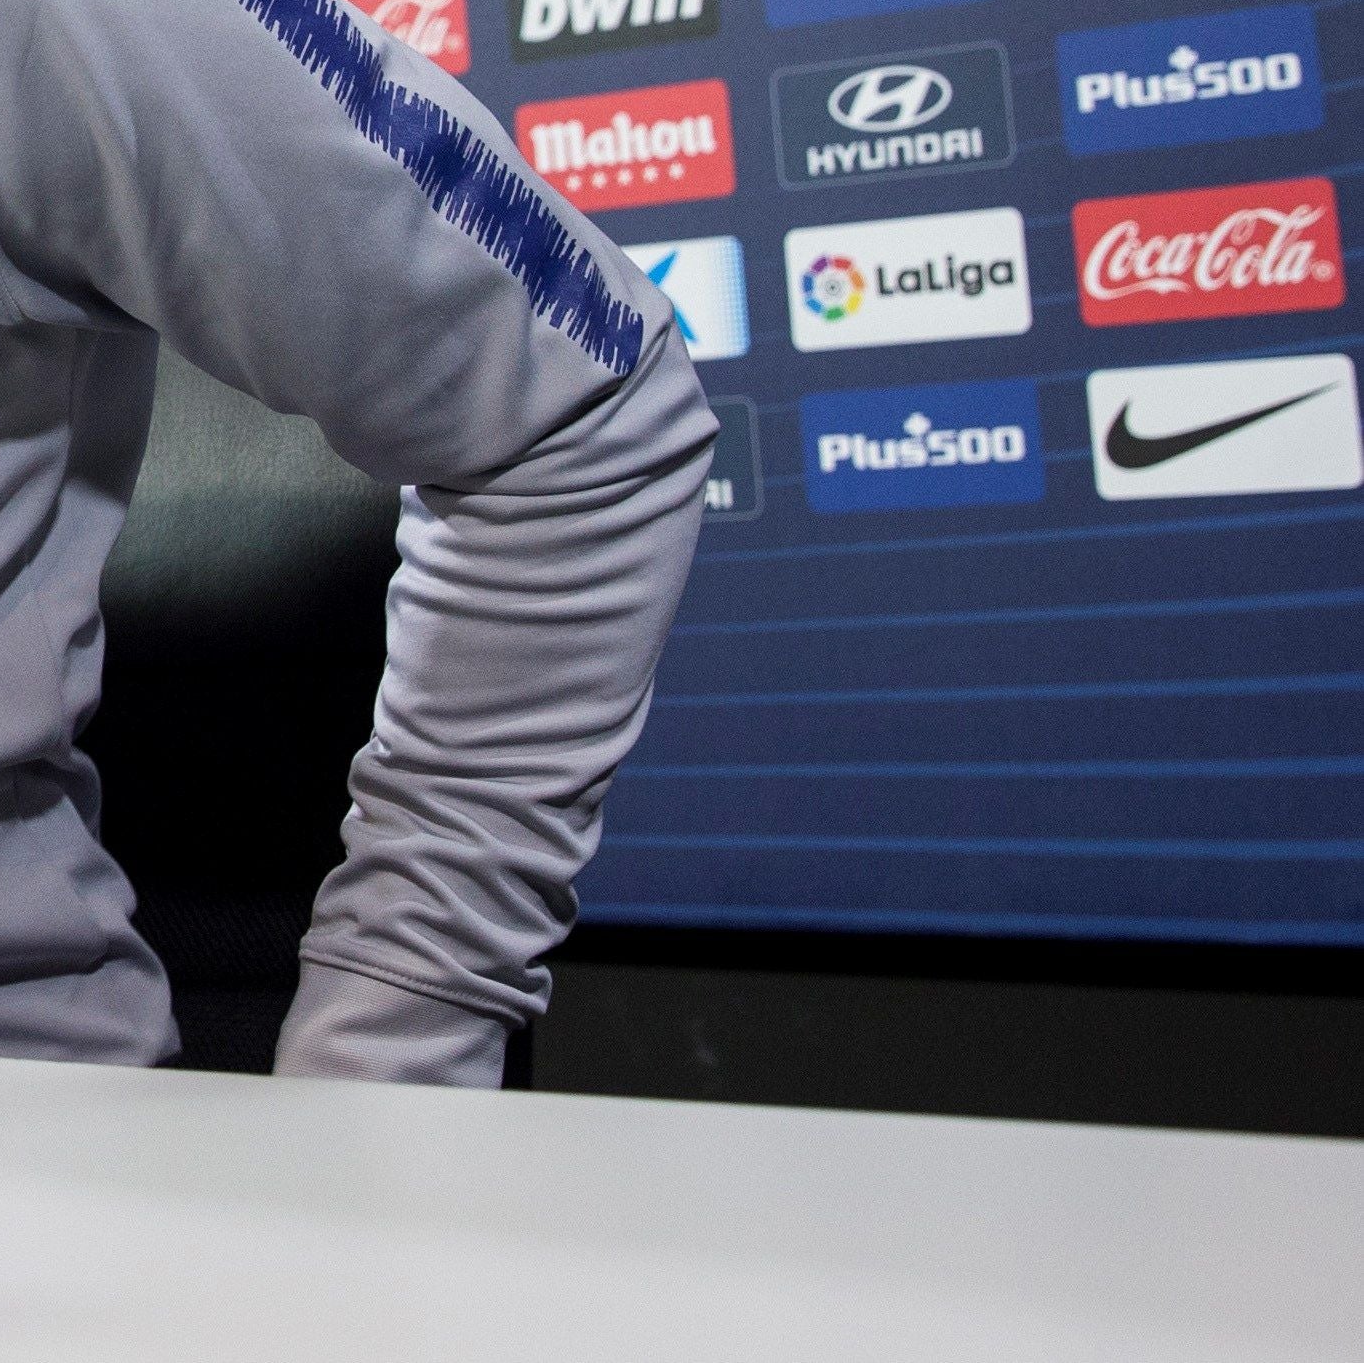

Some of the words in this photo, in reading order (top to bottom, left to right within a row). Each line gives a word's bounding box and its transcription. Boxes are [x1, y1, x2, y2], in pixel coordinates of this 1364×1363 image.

[1077, 48, 1302, 112] Plus500
[531, 112, 715, 176] Mahou
[808, 129, 983, 175] HYUNDAI
[877, 255, 1016, 298] LaLiga
[1084, 205, 1327, 301] Coca-Cola
[819, 422, 1026, 473] Plus500
